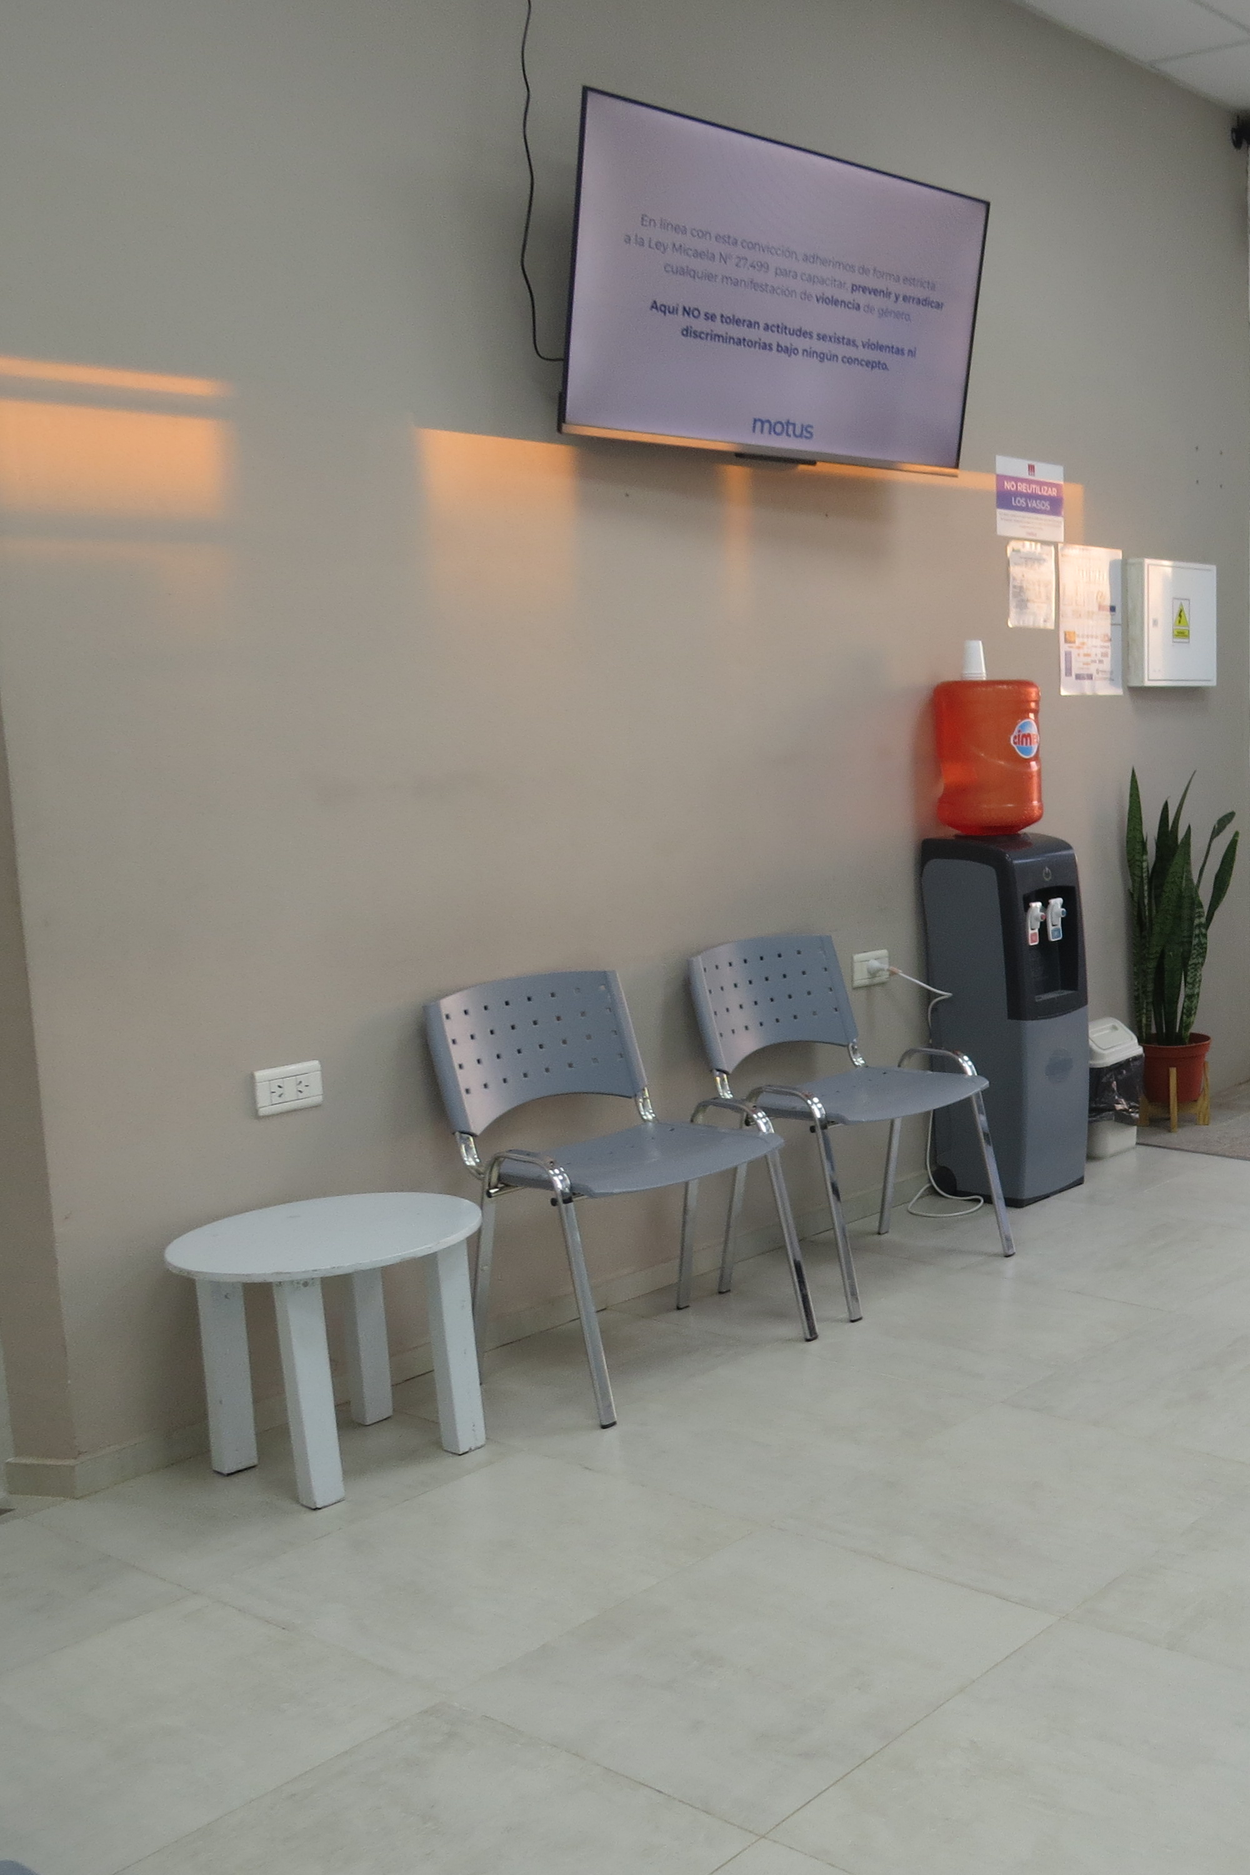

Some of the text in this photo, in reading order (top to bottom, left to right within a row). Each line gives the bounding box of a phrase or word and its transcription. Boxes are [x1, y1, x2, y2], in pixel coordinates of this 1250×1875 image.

[623, 234, 631, 245] a
[635, 233, 645, 247] la
[648, 237, 668, 254] Ley
[672, 243, 716, 262] Micaela
[774, 266, 798, 280] para
[850, 283, 892, 300] prevenir
[893, 292, 900, 303] y
[902, 294, 945, 311] erradicar
[640, 213, 657, 227] En
[690, 228, 712, 241] con
[715, 233, 738, 246] esta
[802, 251, 856, 273] adherimos
[858, 264, 871, 276] de
[872, 266, 900, 283] forma
[903, 275, 936, 291] estricta
[663, 262, 719, 283] cualquier
[799, 290, 813, 302] de
[815, 292, 861, 311] violencia
[862, 303, 876, 315] de
[681, 325, 773, 352] discriminatorias
[776, 341, 799, 358] bajo
[841, 354, 889, 371] concepto.
[682, 305, 701, 319] NO
[704, 312, 717, 323] se
[720, 313, 760, 330] toleran
[763, 322, 813, 340] actitudes
[816, 332, 859, 349] sexistas,
[861, 338, 905, 356] violentas
[907, 347, 917, 358] ni
[752, 417, 814, 440] motus
[1004, 480, 1058, 497] NO REUTILIZAR
[1011, 496, 1051, 511] LOS VASOS
